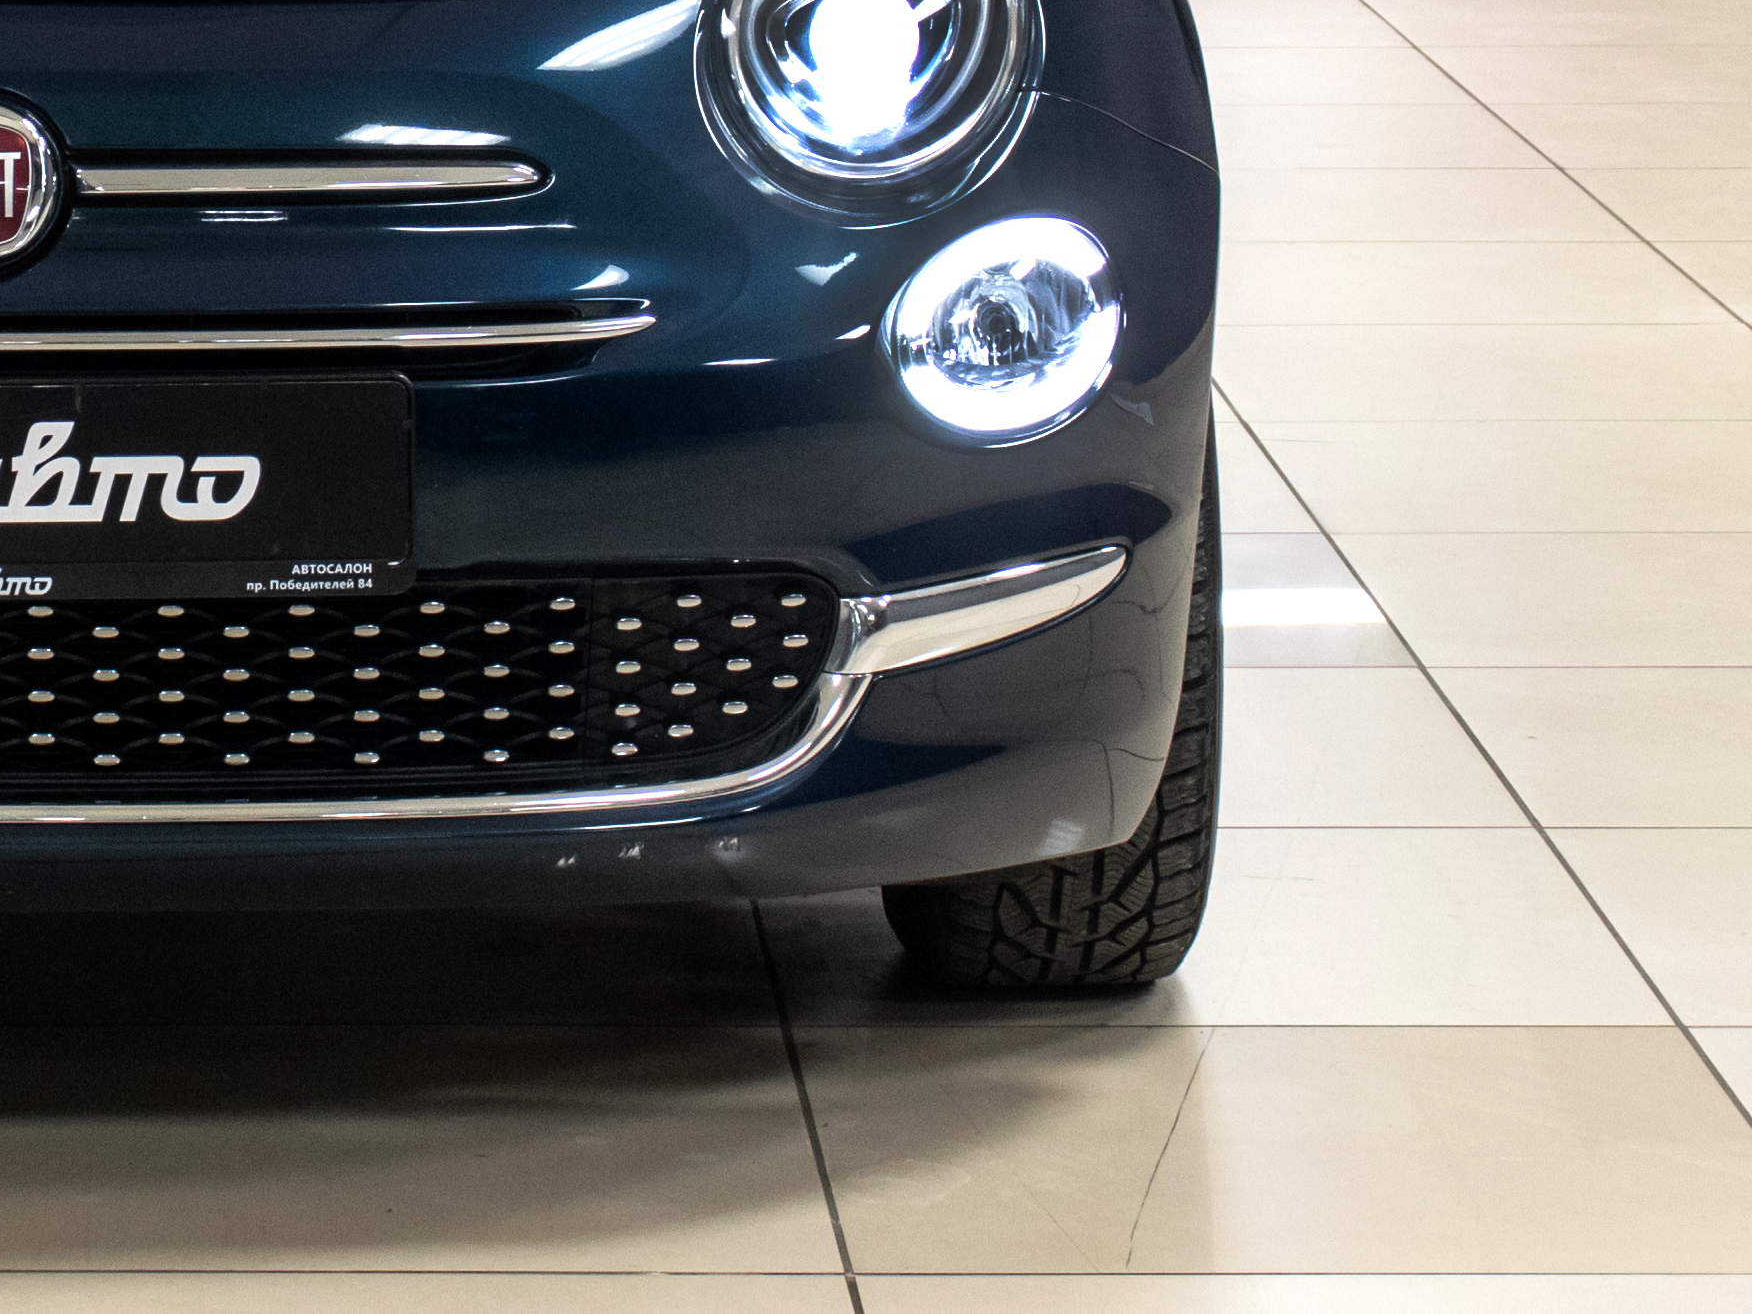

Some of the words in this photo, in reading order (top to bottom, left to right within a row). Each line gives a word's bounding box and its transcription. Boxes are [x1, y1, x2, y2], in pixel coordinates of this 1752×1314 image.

[291, 563, 373, 575] АВТОСАЛОН
[246, 581, 266, 593] пр.
[269, 578, 355, 592] Победителей
[357, 578, 373, 589] 84
